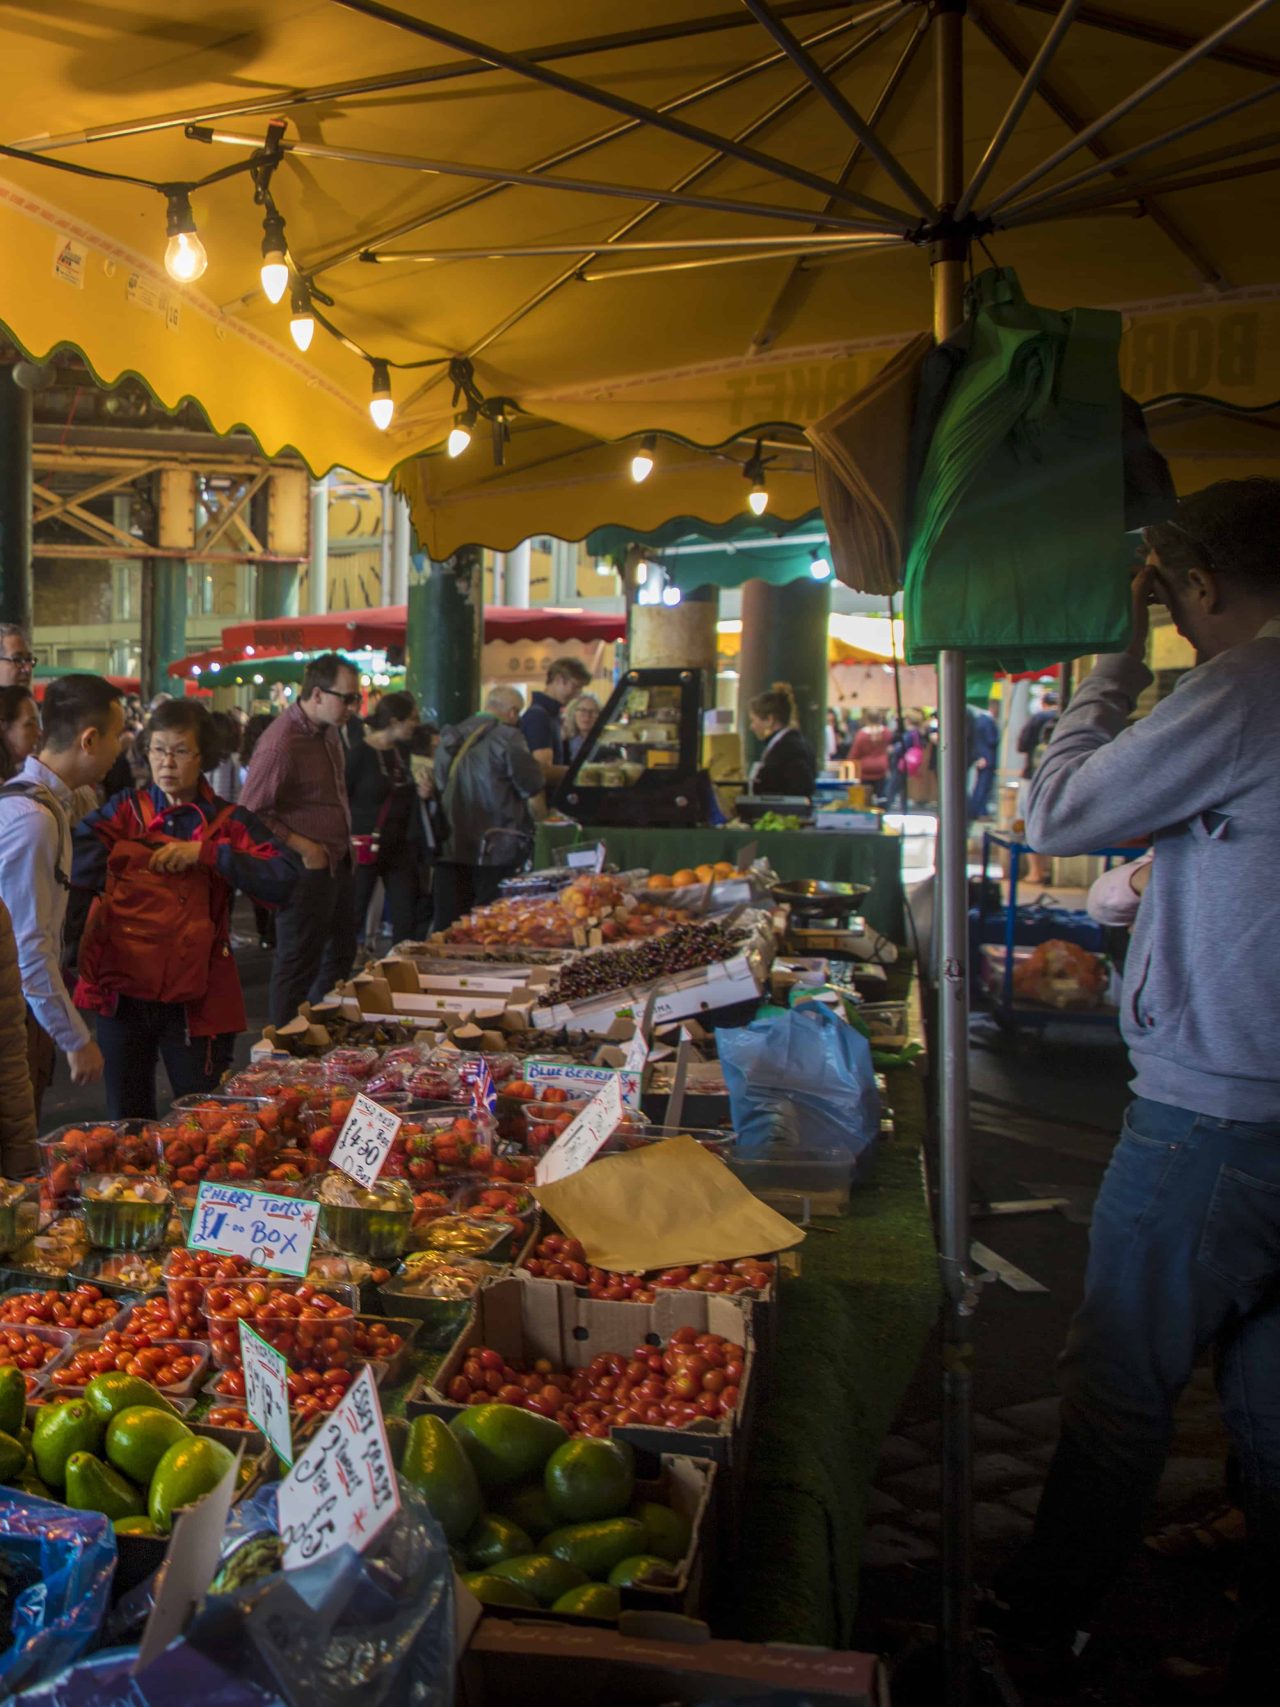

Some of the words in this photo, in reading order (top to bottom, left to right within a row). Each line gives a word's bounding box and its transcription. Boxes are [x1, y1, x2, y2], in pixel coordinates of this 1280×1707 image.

[200, 1185, 254, 1212] CHERRY
[258, 1199, 304, 1216] TOMS
[251, 1219, 298, 1255] BOX
